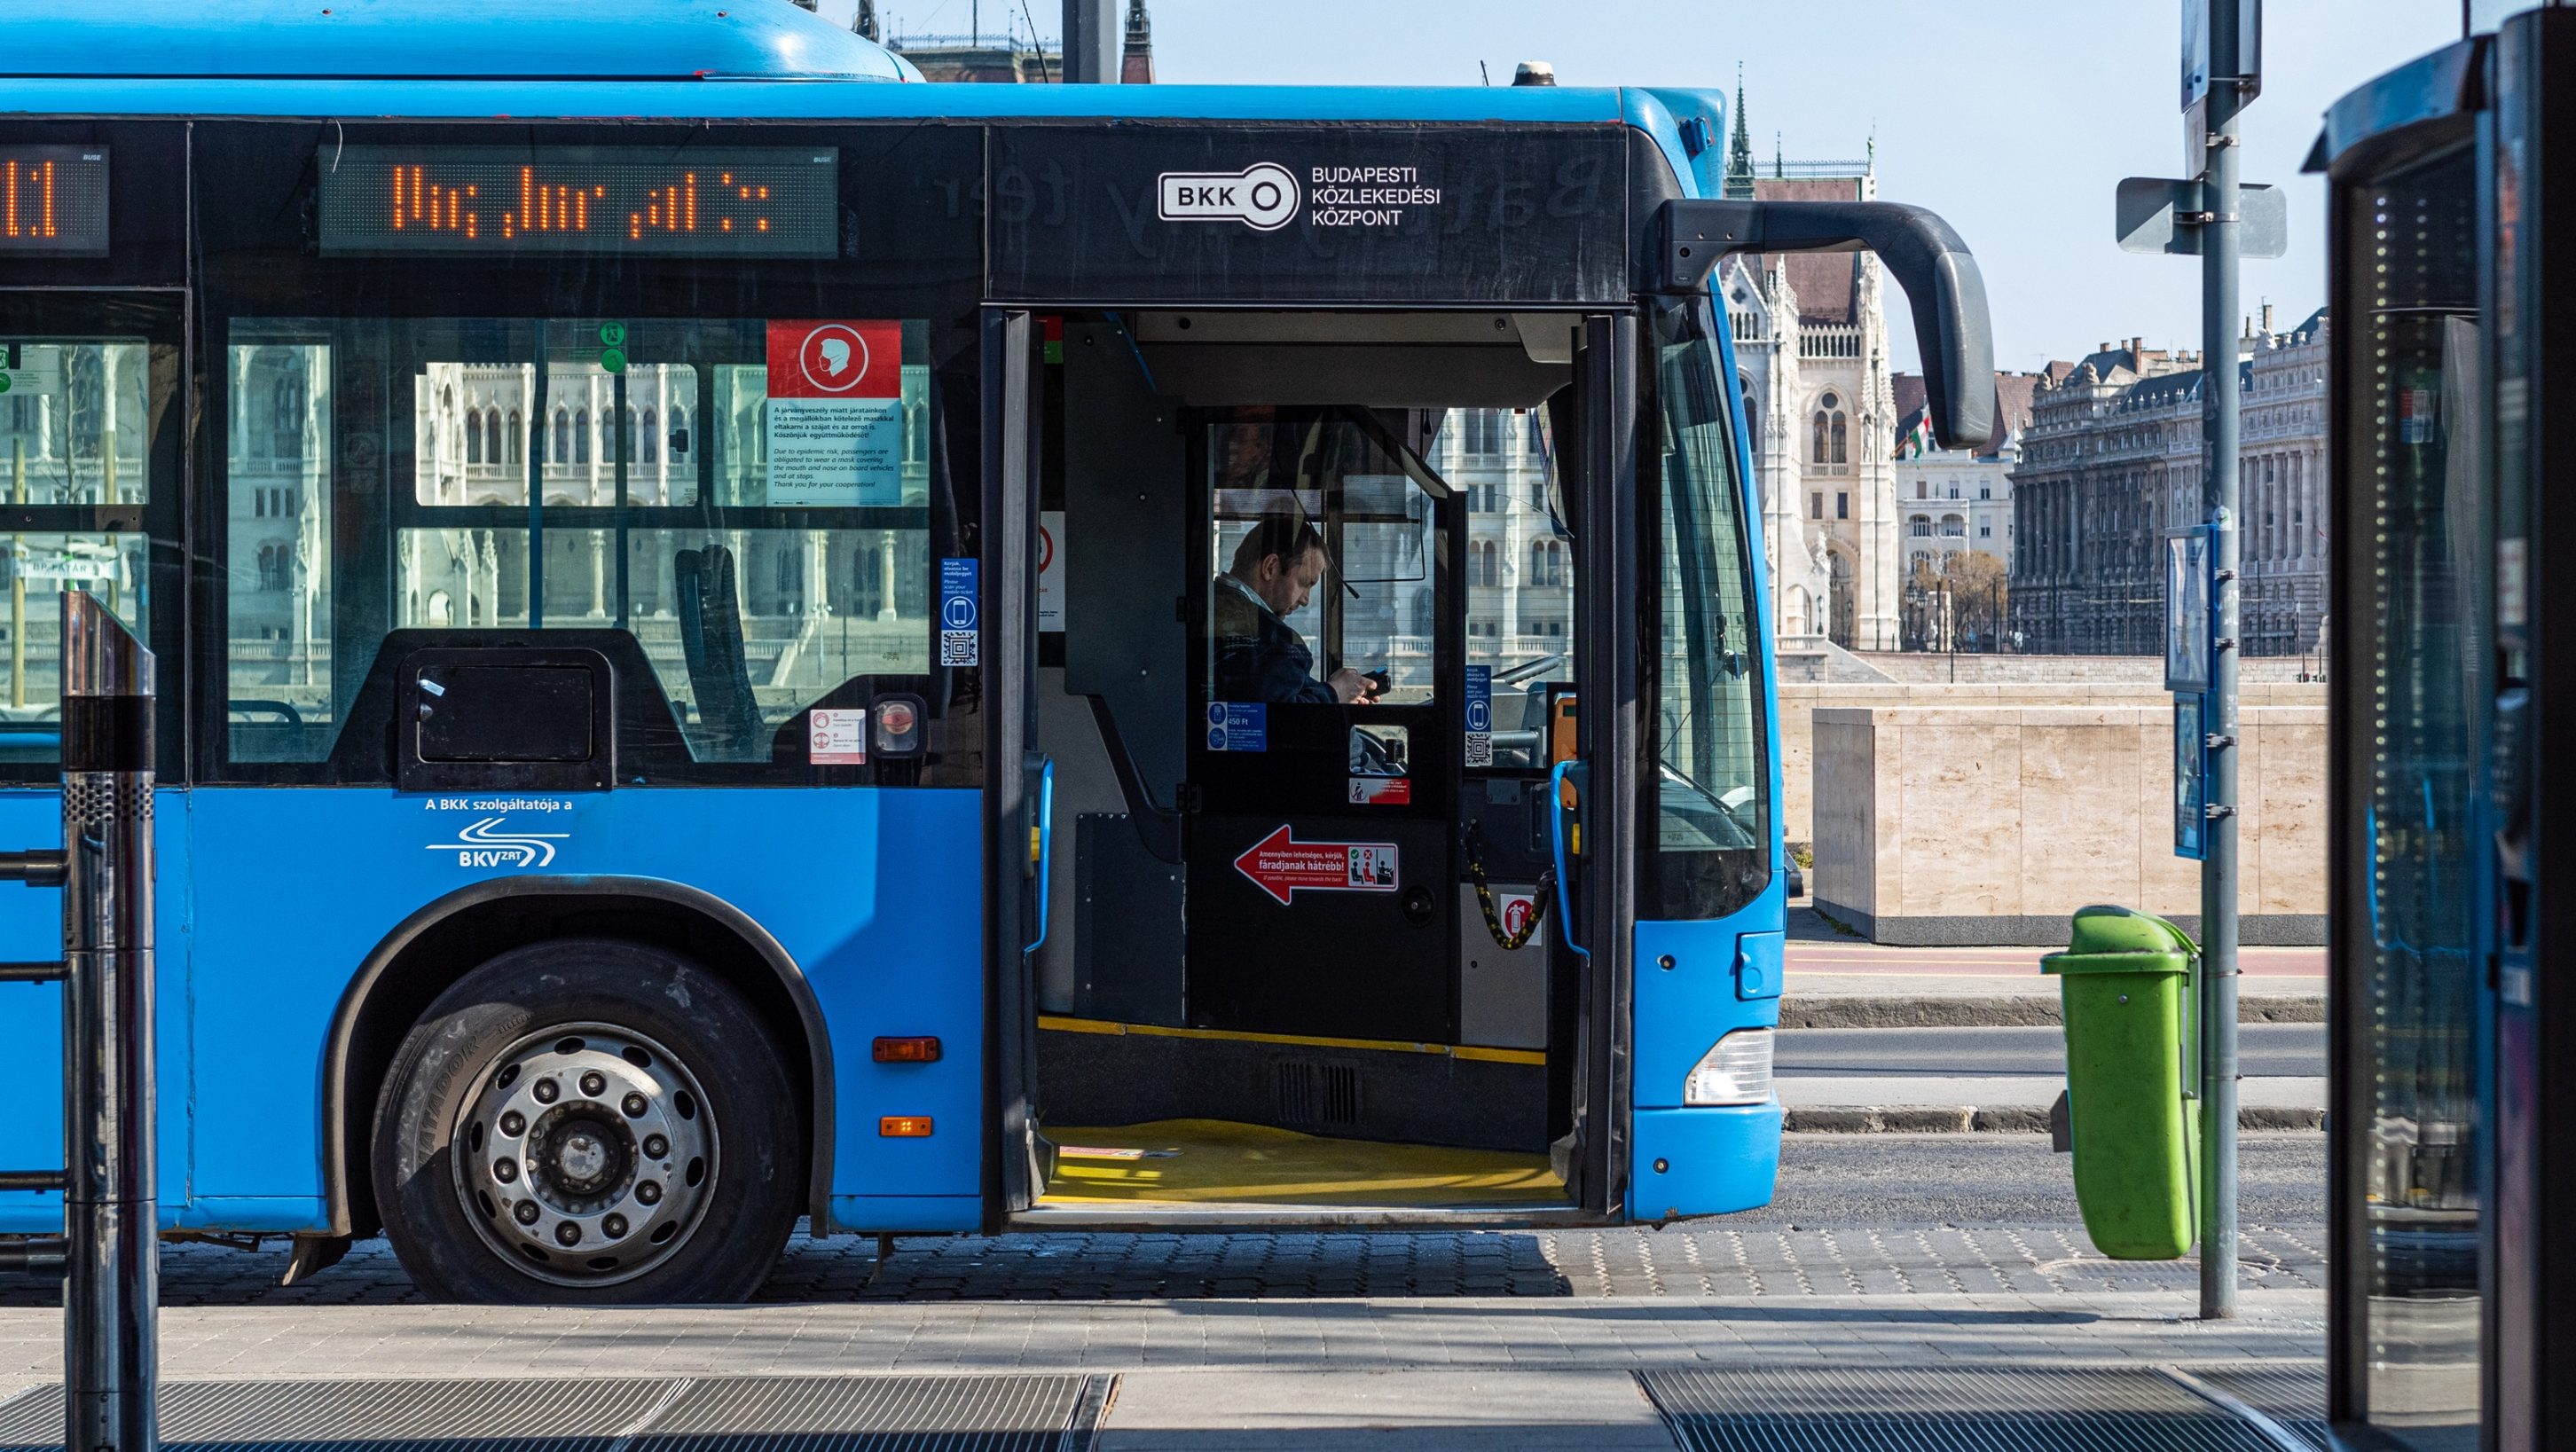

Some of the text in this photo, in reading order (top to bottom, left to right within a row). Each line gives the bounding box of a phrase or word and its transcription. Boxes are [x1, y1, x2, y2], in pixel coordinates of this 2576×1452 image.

[1312, 167, 1417, 183] BUDAPESTI
[1178, 187, 1237, 206] BKK
[1312, 185, 1441, 204] KÖZLEKEDÉSI
[1312, 208, 1402, 226] KÖZPONT
[425, 798, 572, 813] A BKK szolgáltatója a
[459, 852, 500, 867] BKV
[1293, 852, 1323, 860] lehetséges,
[1260, 860, 1345, 872] fáradjanak hátrébb!
